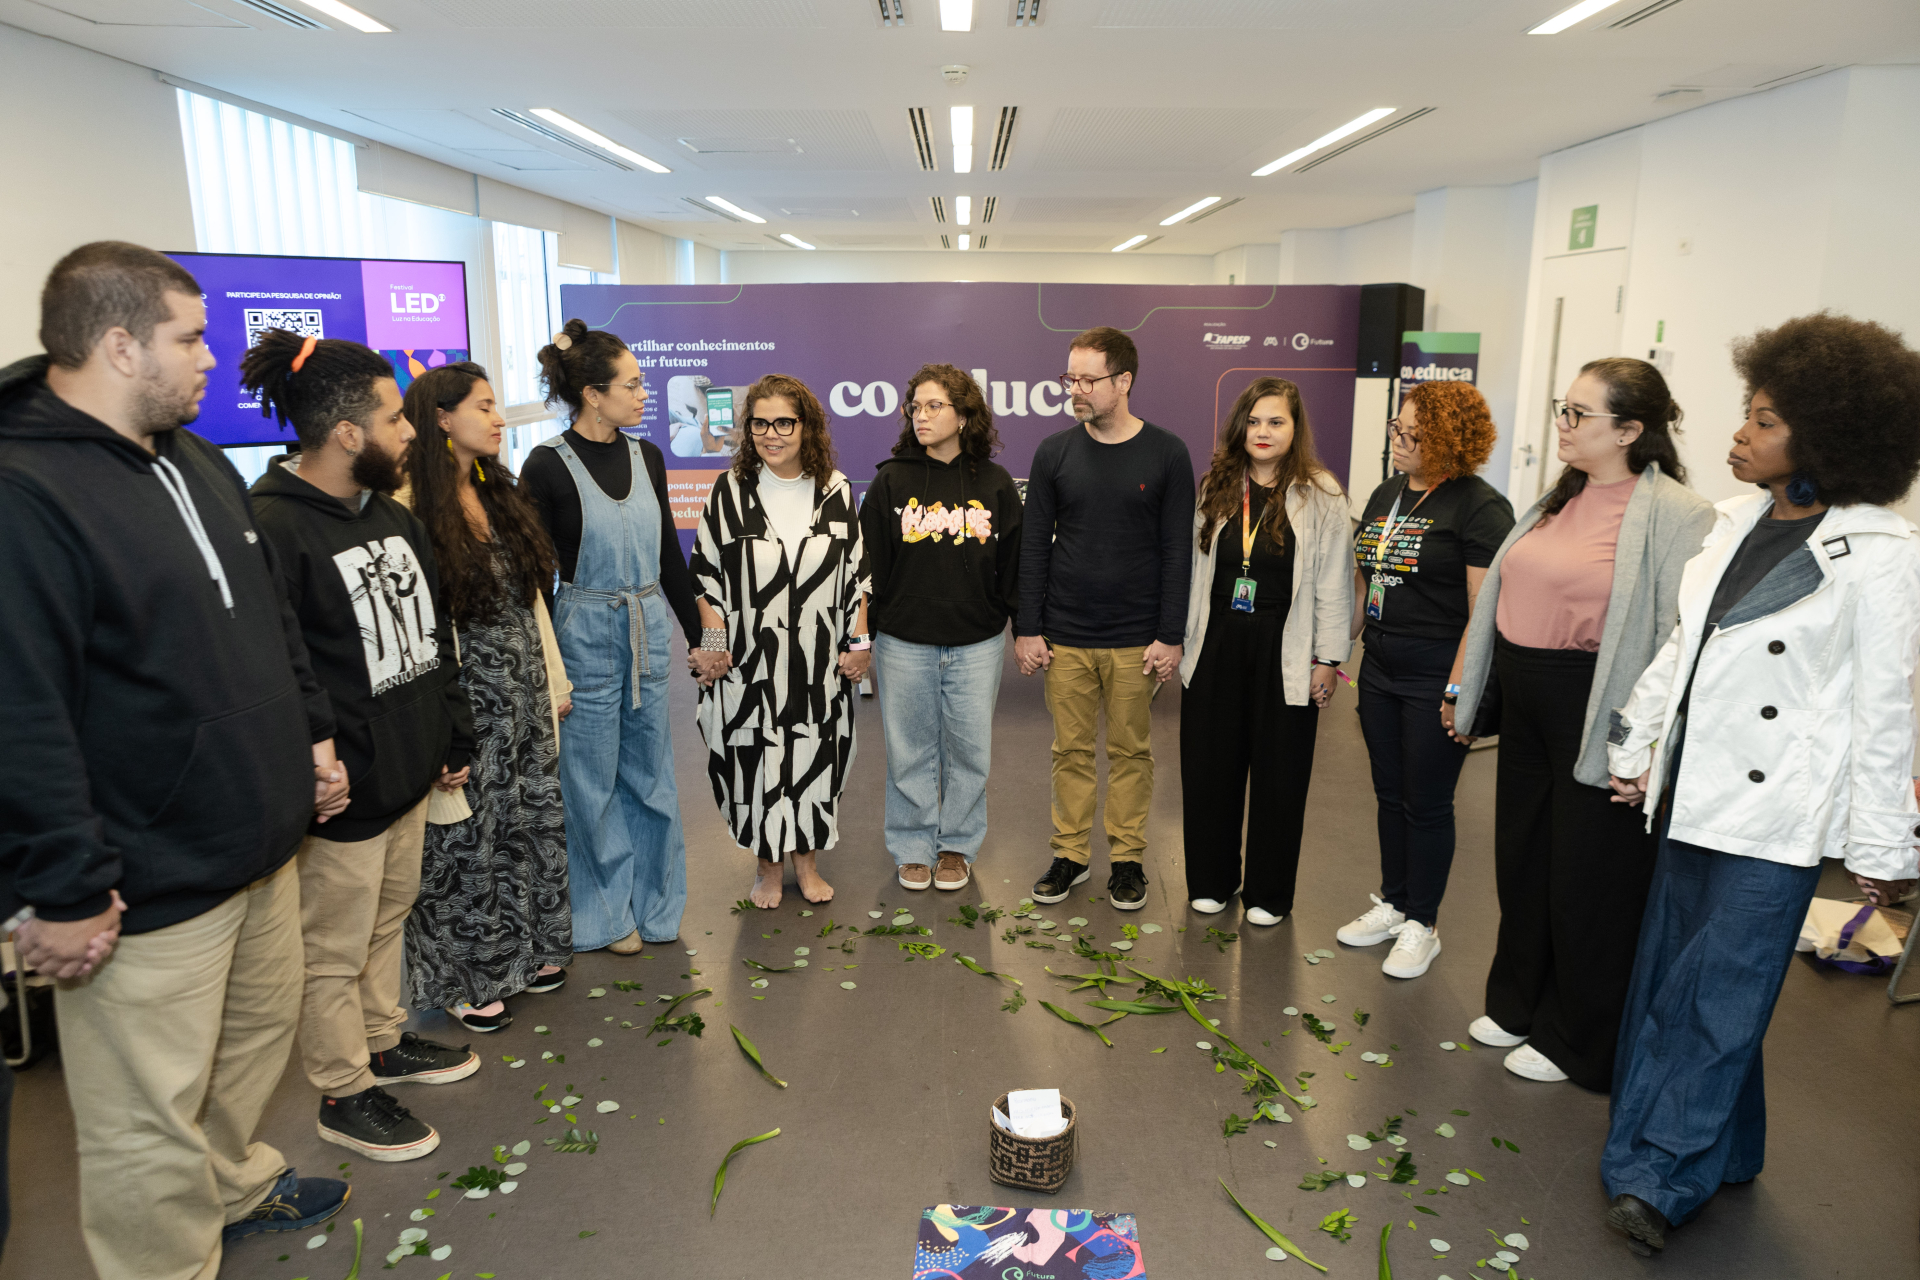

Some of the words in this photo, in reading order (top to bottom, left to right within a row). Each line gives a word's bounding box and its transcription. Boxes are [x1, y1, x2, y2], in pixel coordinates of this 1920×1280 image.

[226, 291, 261, 299] PARTICIPE
[271, 292, 304, 300] PESQUISA
[313, 292, 342, 300] OPINIÃO!
[390, 292, 440, 314] LED
[412, 315, 441, 324] Educação
[1216, 335, 1251, 345] FAPESP
[625, 339, 675, 352] artilhar
[676, 339, 776, 352] conhecimentos
[637, 355, 657, 368] uir
[659, 355, 709, 368] futuros
[695, 482, 714, 492] par
[1026, 1269, 1056, 1280] Futura
